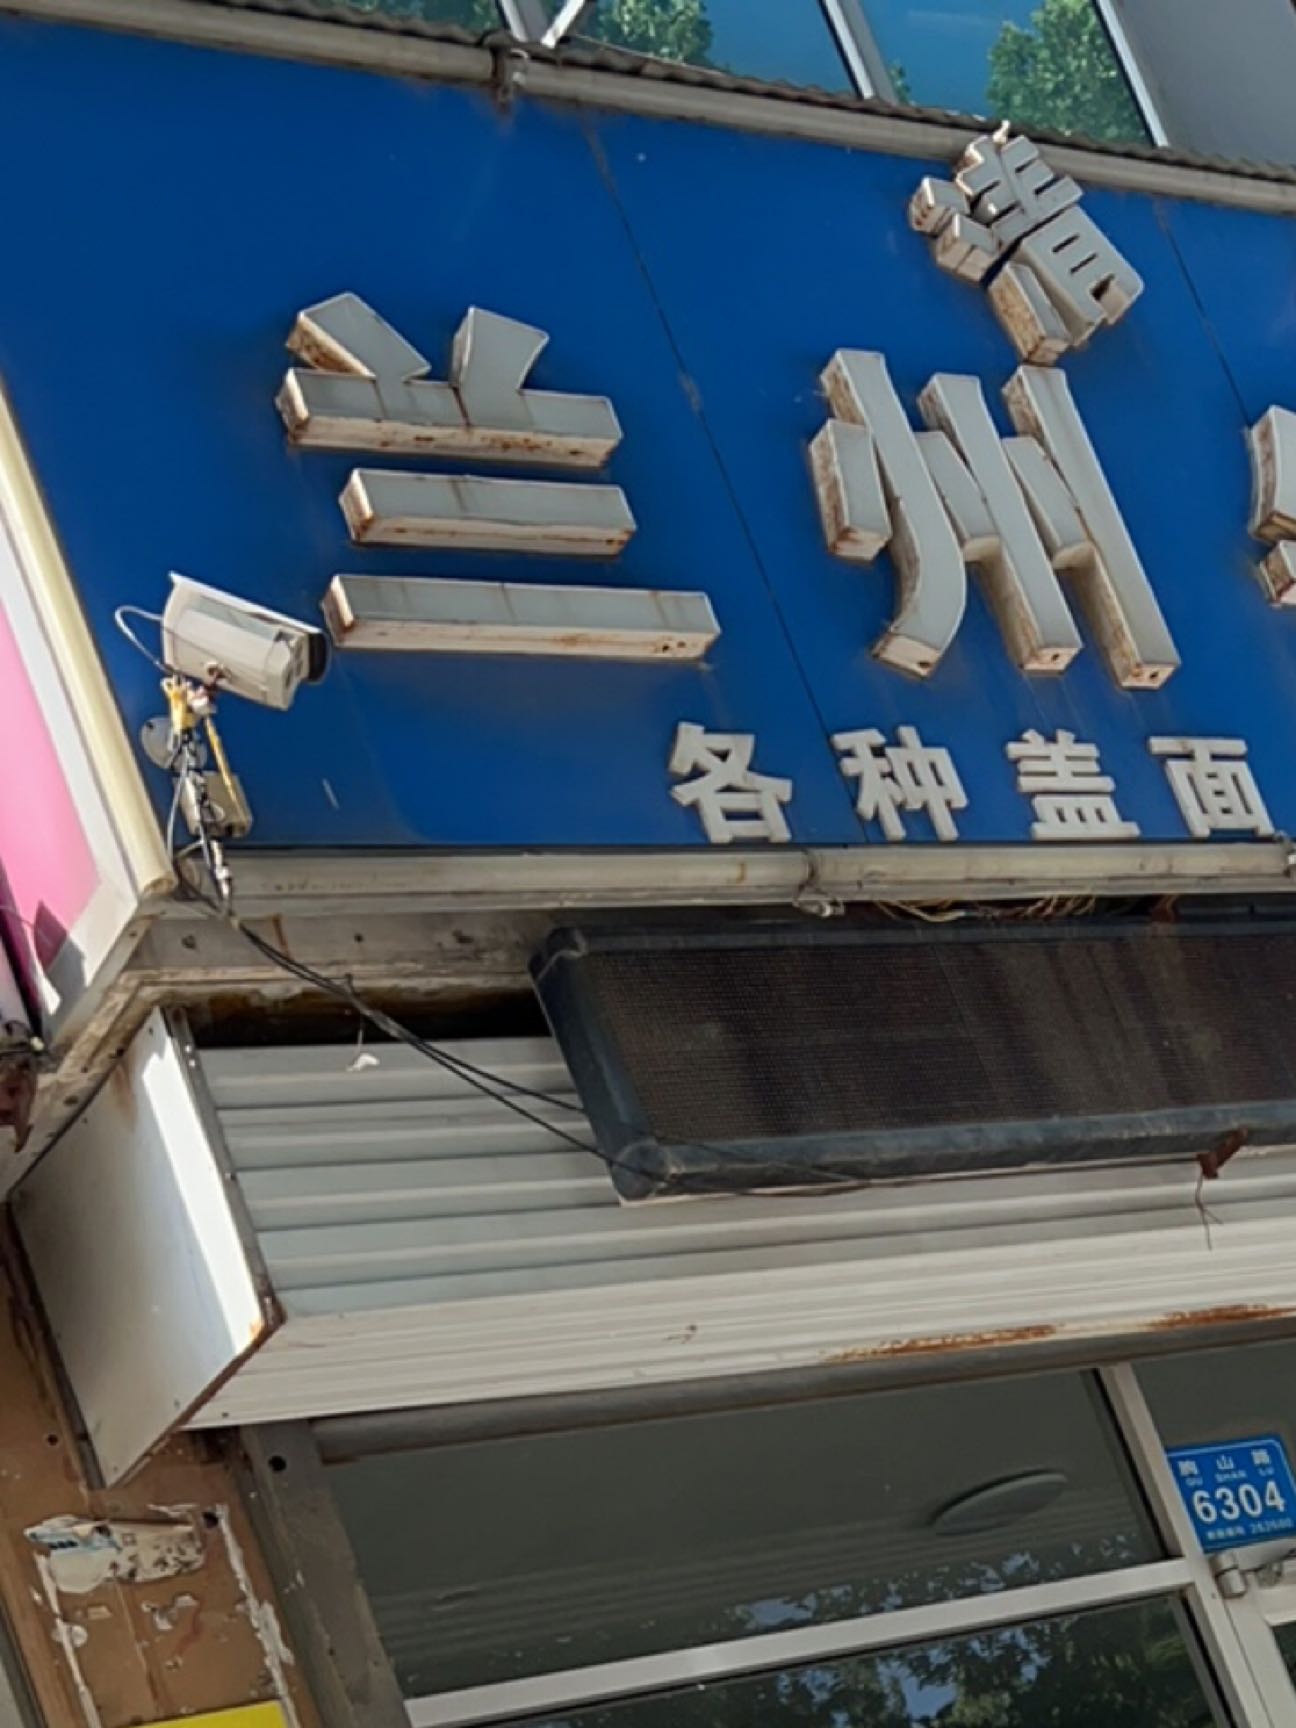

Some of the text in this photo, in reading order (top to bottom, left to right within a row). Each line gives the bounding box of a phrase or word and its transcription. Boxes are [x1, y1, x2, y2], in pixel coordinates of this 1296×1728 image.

[909, 131, 1143, 364] 清
[669, 721, 1275, 844] 各种盖面
[1193, 1480, 1285, 1524] 6304
